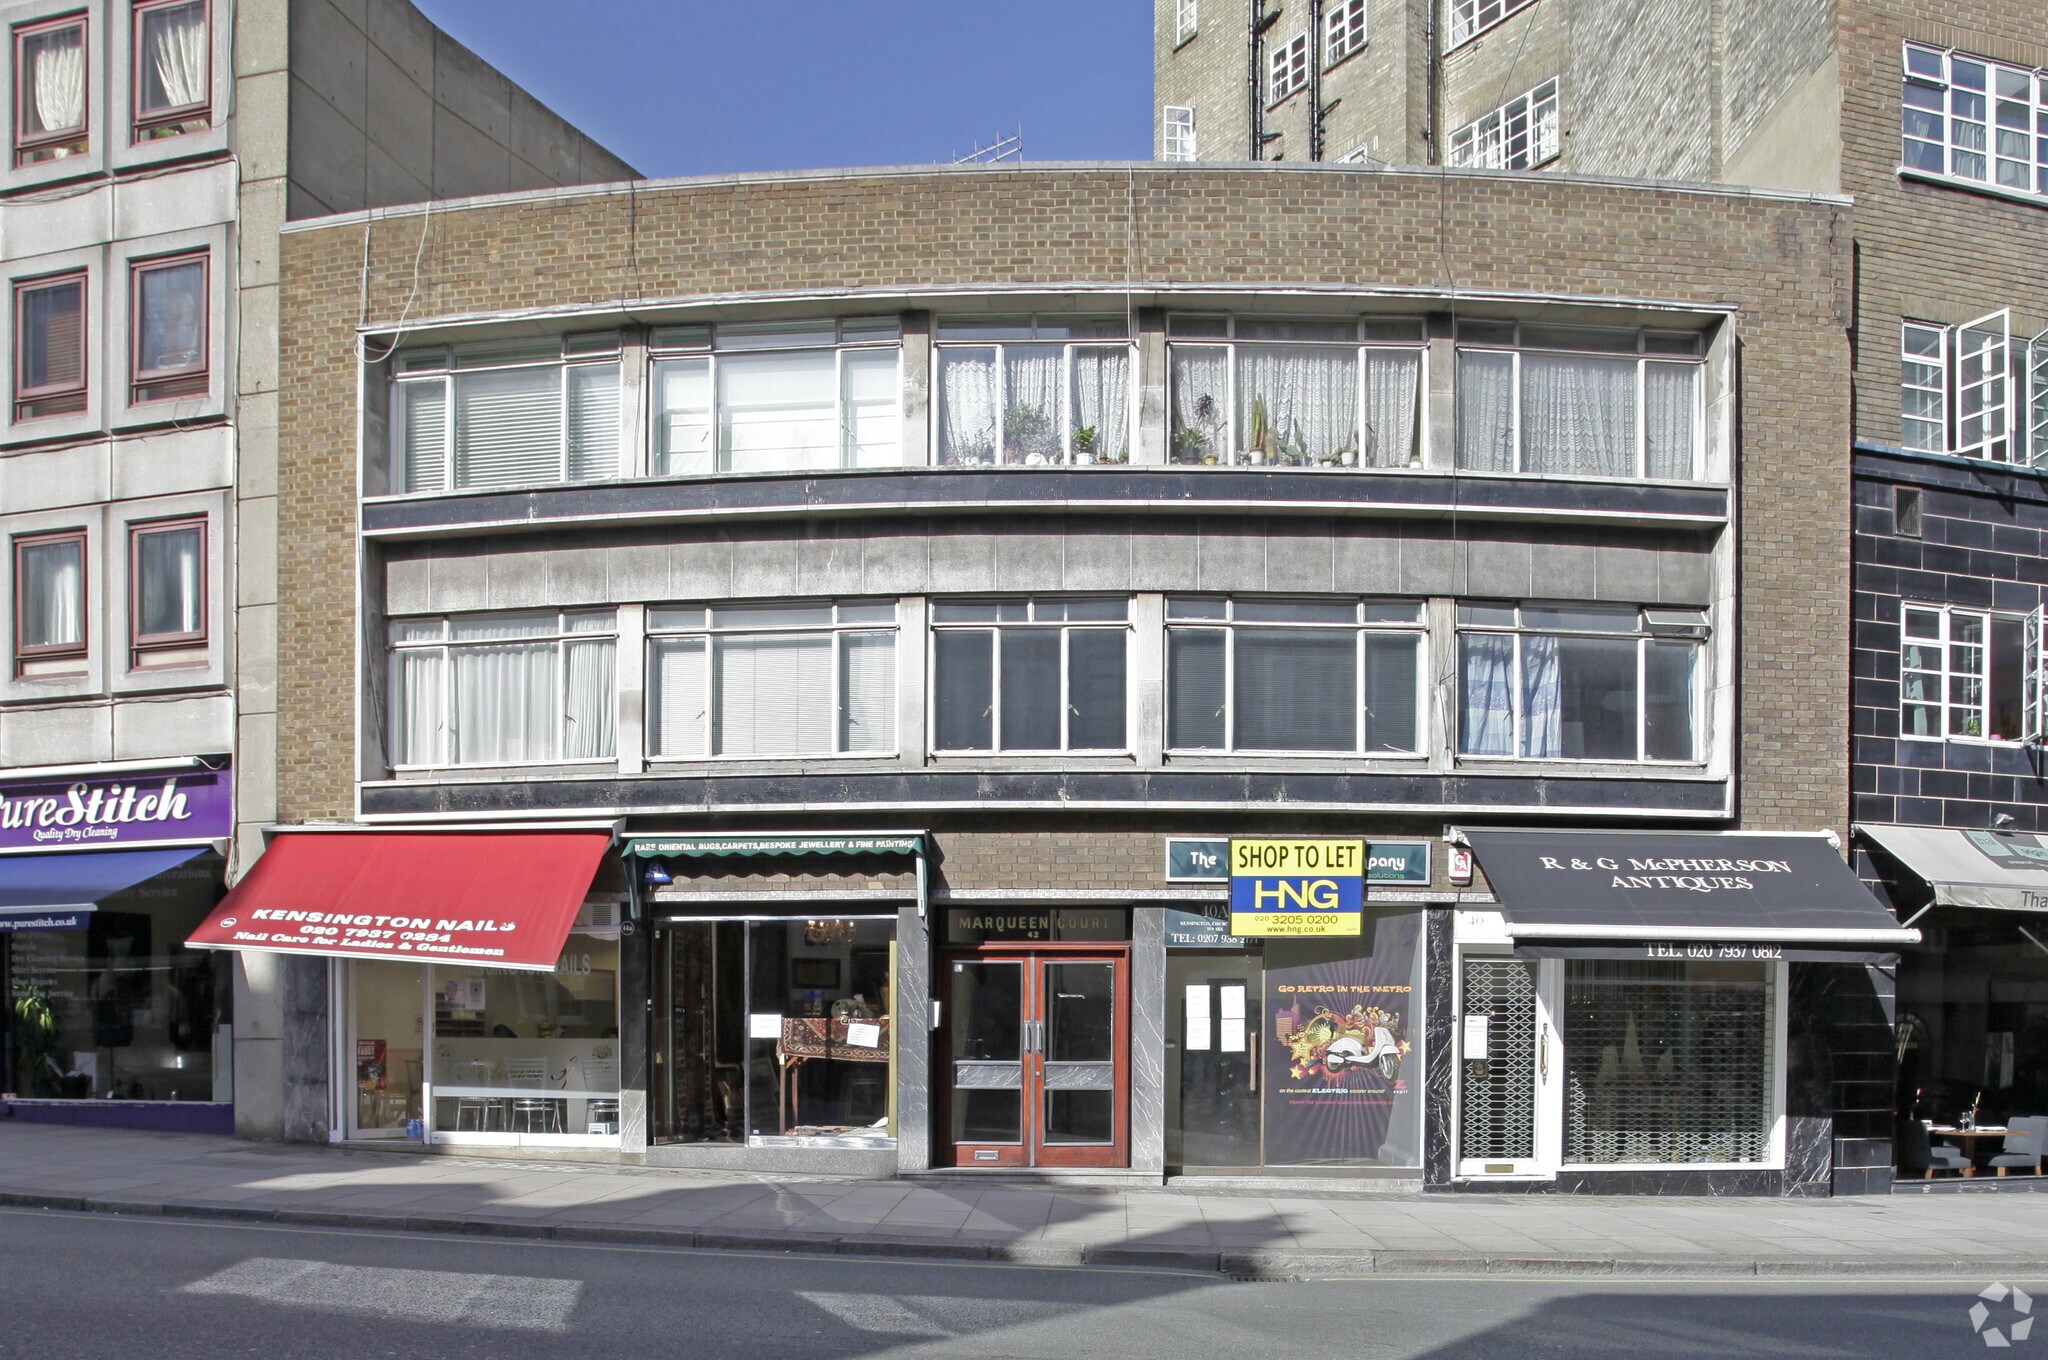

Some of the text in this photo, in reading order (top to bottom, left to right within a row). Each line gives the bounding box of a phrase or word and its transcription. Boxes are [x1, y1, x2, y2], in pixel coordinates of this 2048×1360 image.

[33, 826, 118, 842] Quality Dry Cleaning
[634, 843, 656, 852] RARE
[658, 843, 696, 851] ORIENTAL
[798, 840, 846, 849] JEWELLERY
[847, 840, 855, 848] &
[856, 840, 874, 848] FINE
[875, 839, 915, 848] PAINTING
[1189, 851, 1218, 869] The
[1238, 845, 1356, 868] SHOP TO LET
[1368, 857, 1405, 871] pany
[1539, 857, 1793, 873] R & G McPHERSON
[1611, 875, 1754, 893] ANTIQUES
[1254, 879, 1339, 909] HNG
[2020, 890, 2048, 908] Tha
[252, 909, 431, 930] KENSINGTON
[958, 916, 1110, 932] MARQUEEN COURT
[1272, 915, 1303, 924] 3205
[1306, 915, 1338, 924] 0200
[299, 925, 452, 943] 020 7937 0284
[1027, 931, 1039, 939] 42
[1266, 925, 1326, 934] www.hng.co.uk
[233, 931, 505, 956] Nail Care for Ladies & Gentlemen
[1171, 933, 1195, 943] TEL:
[1197, 934, 1219, 943] 0207
[1643, 942, 1782, 959] TEL. 020 7937 0812
[556, 953, 592, 976] AILS
[1278, 985, 1296, 993] GO
[1297, 985, 1335, 993] RETRO
[1350, 985, 1371, 993] THE
[1372, 985, 1412, 993] METRO
